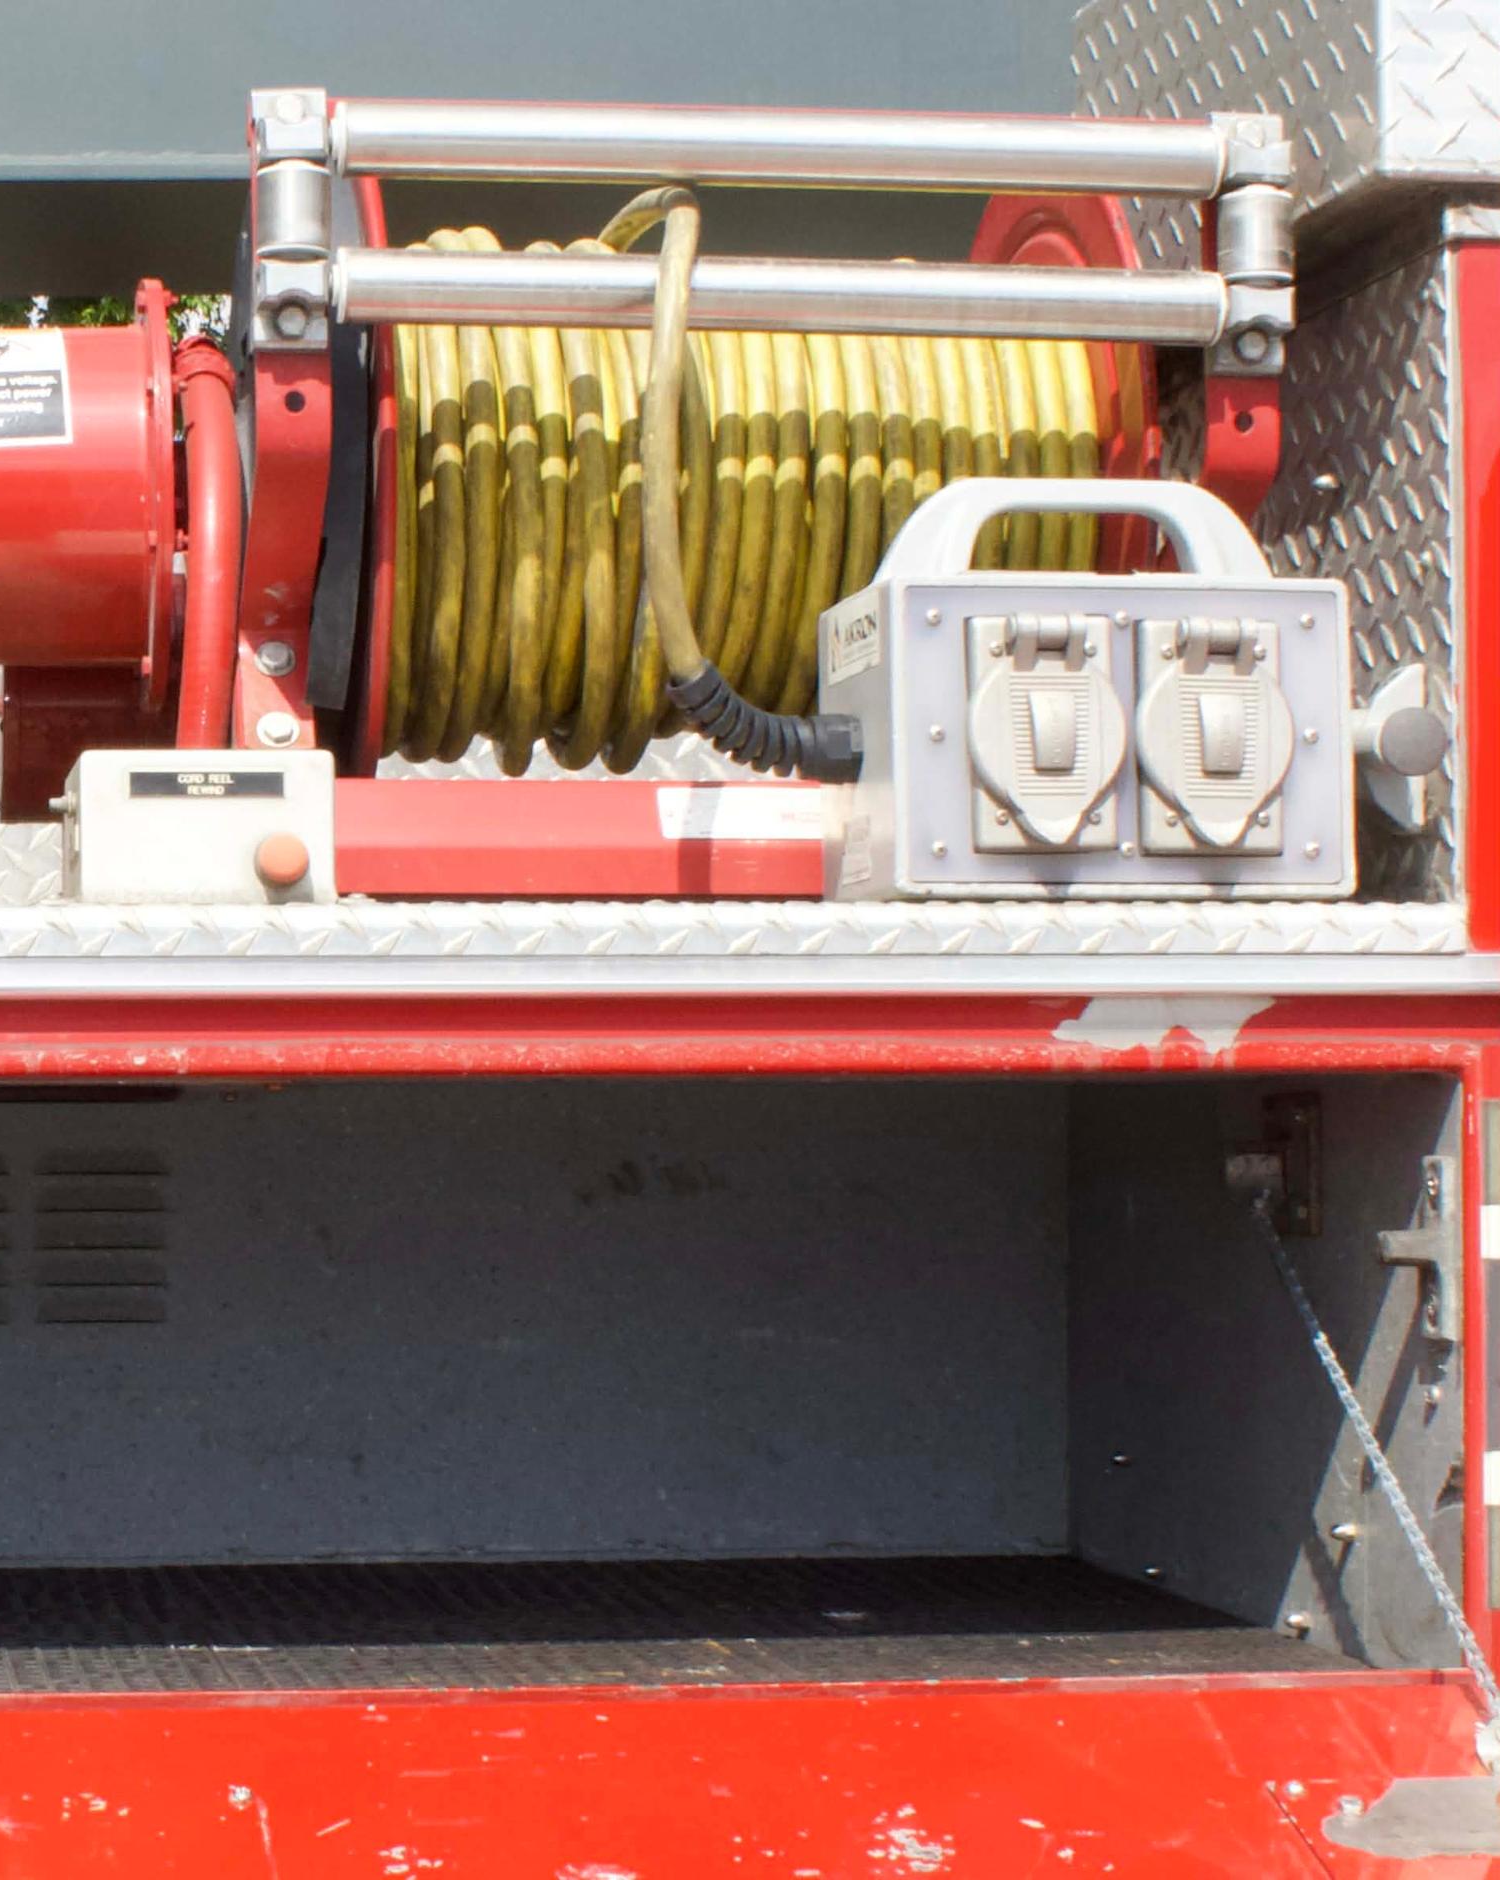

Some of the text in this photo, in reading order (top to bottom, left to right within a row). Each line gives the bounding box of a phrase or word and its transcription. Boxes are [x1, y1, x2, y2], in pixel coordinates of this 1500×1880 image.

[12, 388, 52, 401] power
[177, 773, 234, 784] CORD REEL
[187, 785, 225, 795] REWIND
